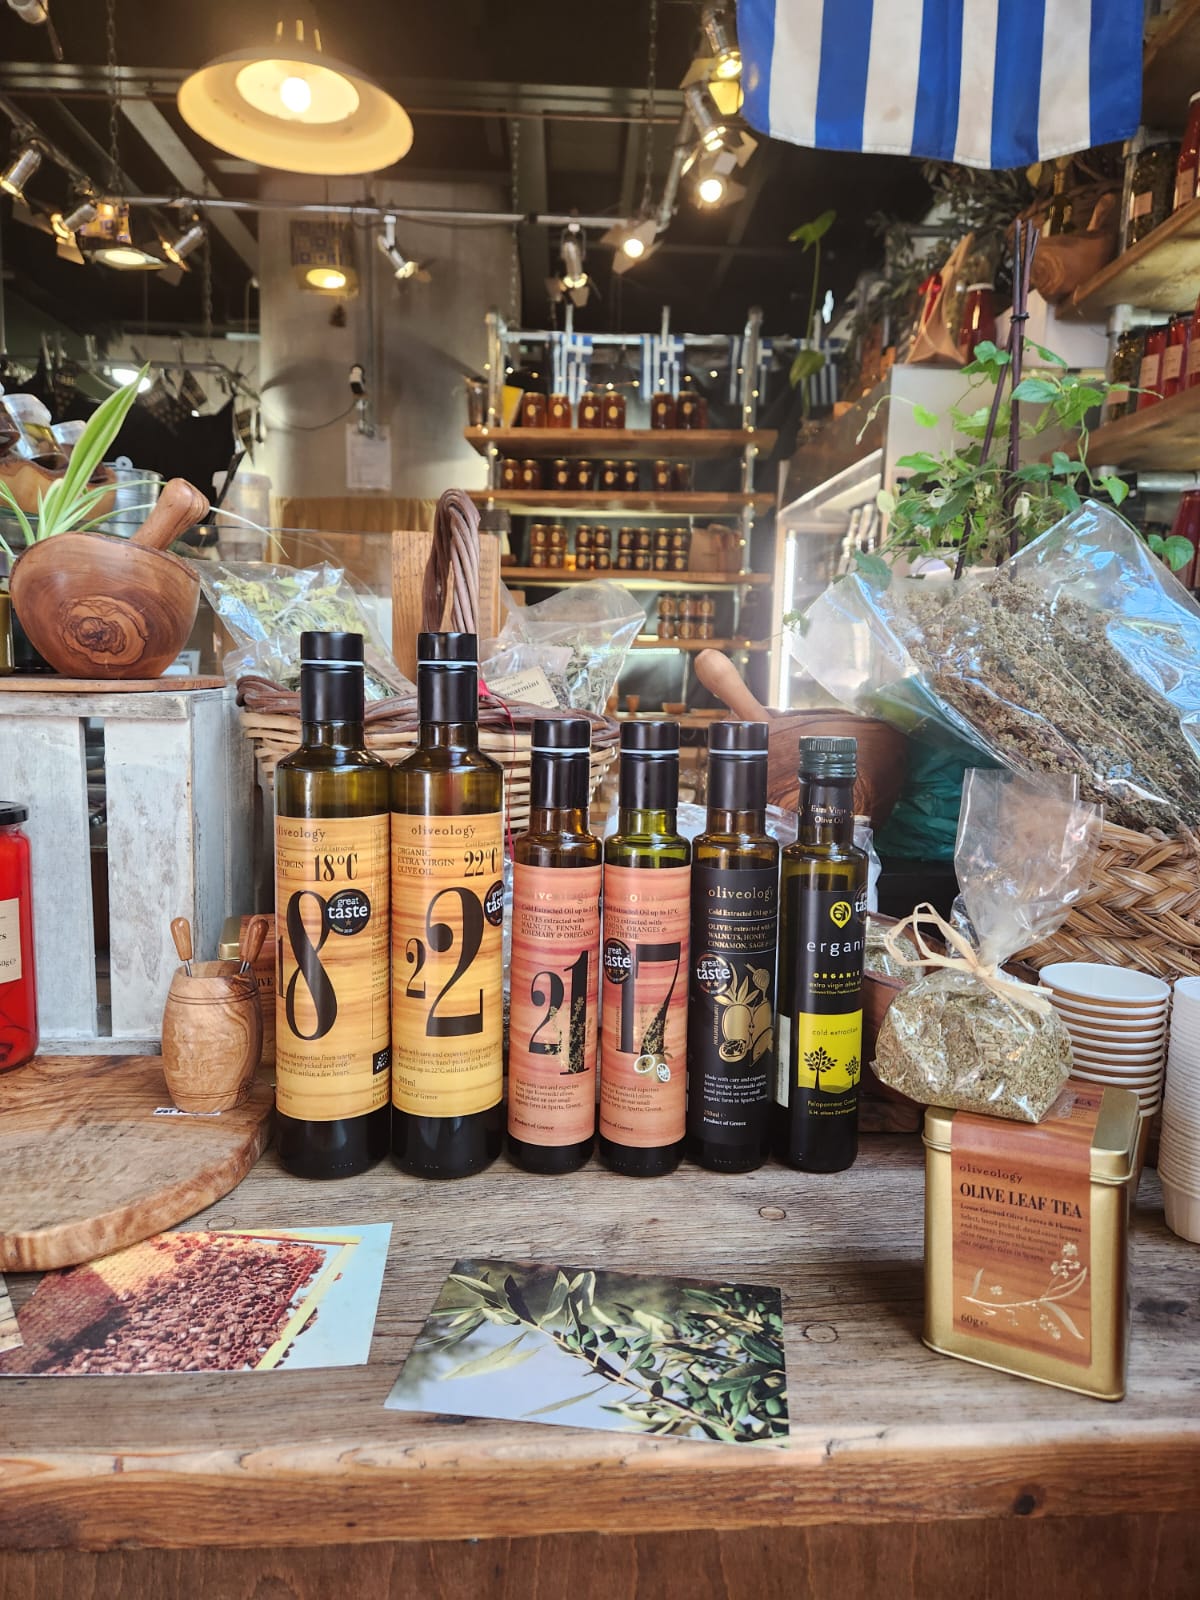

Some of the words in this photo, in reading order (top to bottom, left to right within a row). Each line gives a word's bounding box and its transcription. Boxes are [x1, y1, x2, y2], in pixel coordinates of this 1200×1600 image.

[815, 816, 832, 824] Olive
[278, 825, 325, 842] liveology
[410, 824, 475, 838] oliveology
[398, 847, 431, 856] ORGANIC
[398, 856, 419, 866] EXTRA
[422, 858, 455, 866] VIRGIN
[314, 852, 358, 881] 18°C
[398, 865, 418, 874] OLIVE
[337, 897, 359, 908] great
[328, 906, 368, 919] taste
[534, 906, 563, 914] Extracted
[723, 909, 752, 917] Extracted
[522, 914, 542, 923] OLIVES
[617, 931, 640, 939] THYME
[708, 932, 743, 941] WALNUTS,
[806, 937, 864, 957] ergani
[604, 955, 631, 968] taste
[702, 960, 720, 969] great
[696, 968, 730, 980] taste
[813, 970, 860, 979] ORGANIC
[528, 949, 590, 1075] 21
[812, 1028, 828, 1036] cold
[959, 1163, 1023, 1184] oliveology
[960, 1183, 1005, 1203] OLIVE
[1008, 1191, 1048, 1211] LEAF
[1051, 1199, 1082, 1219] TEA
[961, 1314, 979, 1328] 60g
